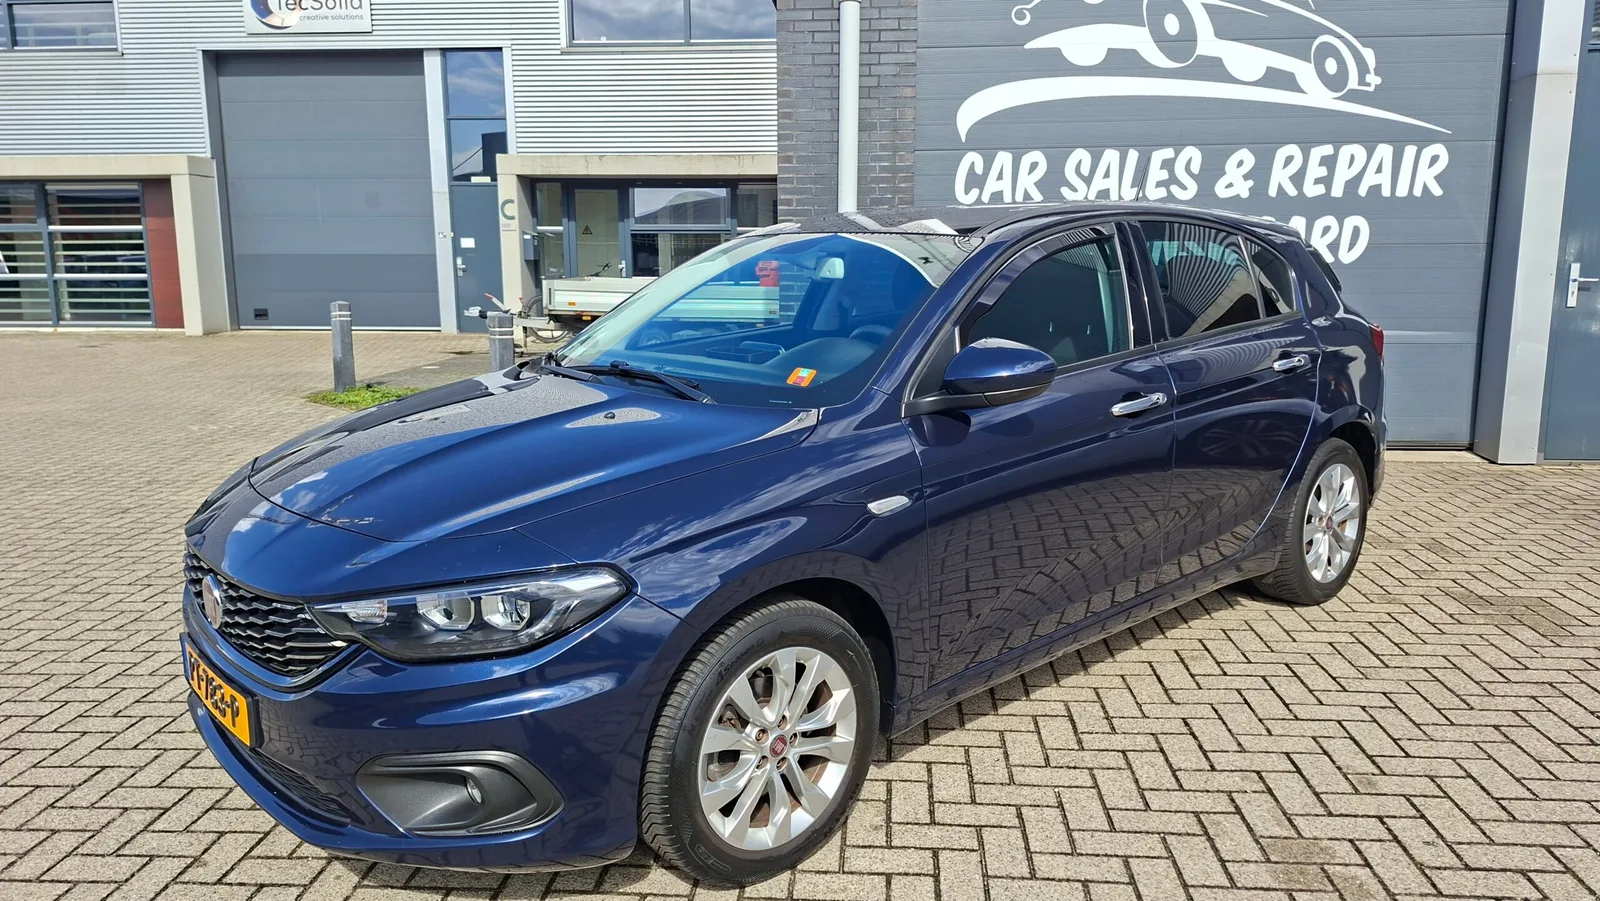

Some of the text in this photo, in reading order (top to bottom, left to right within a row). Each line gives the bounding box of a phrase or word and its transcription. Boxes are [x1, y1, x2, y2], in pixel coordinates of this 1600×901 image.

[299, 12, 364, 21] creative solutions
[954, 143, 1450, 205] CAR SALES & REPAIR
[500, 198, 516, 220] C
